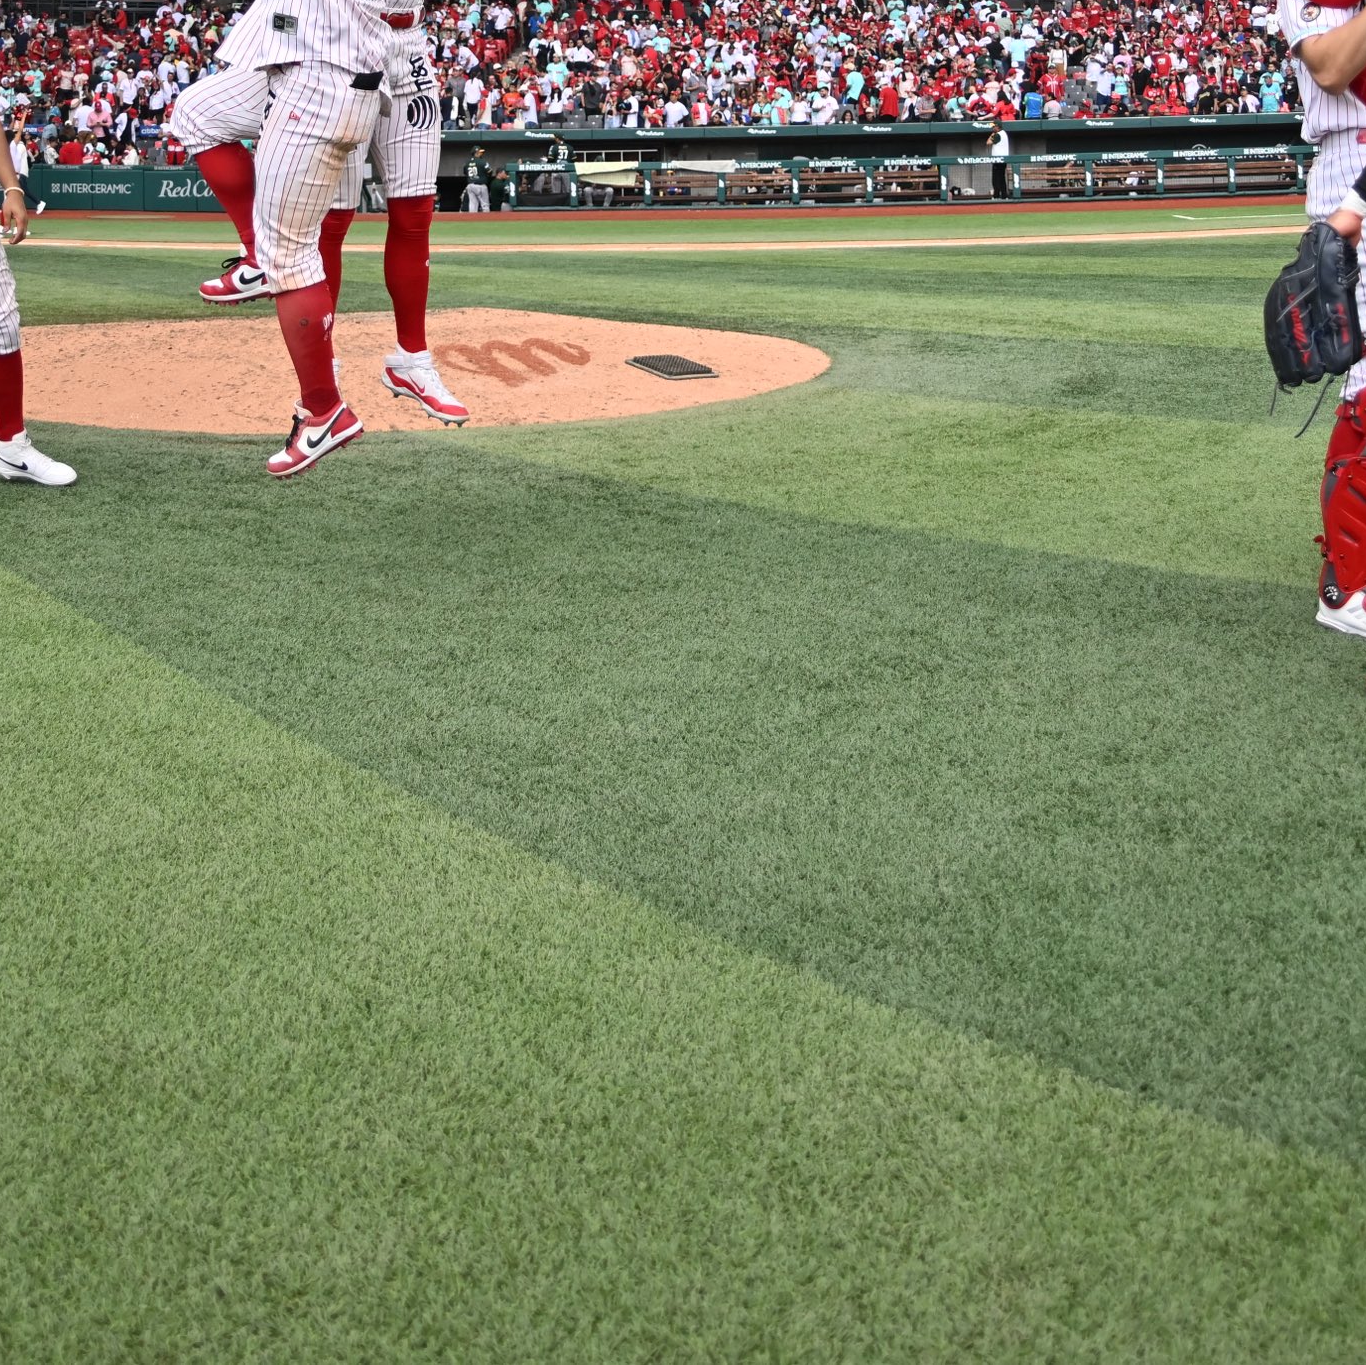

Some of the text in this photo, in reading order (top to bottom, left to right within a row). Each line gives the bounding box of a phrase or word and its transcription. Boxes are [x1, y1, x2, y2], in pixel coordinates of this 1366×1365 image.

[558, 149, 569, 160] 37
[1108, 151, 1149, 160] INTERCERAMIC
[1179, 148, 1218, 158] INTERCERAMIC
[1249, 147, 1287, 155] INTERCERAMIC
[890, 157, 932, 166] INTERCERAMIC
[1036, 153, 1077, 162] INTERCERAMIC
[526, 163, 566, 171] INTERCERAMIC
[740, 161, 783, 169] INTERCERAMIC
[815, 159, 857, 167] INTERCERAMIC
[62, 184, 132, 195] INTERCERAMIC
[158, 179, 191, 197] Red
